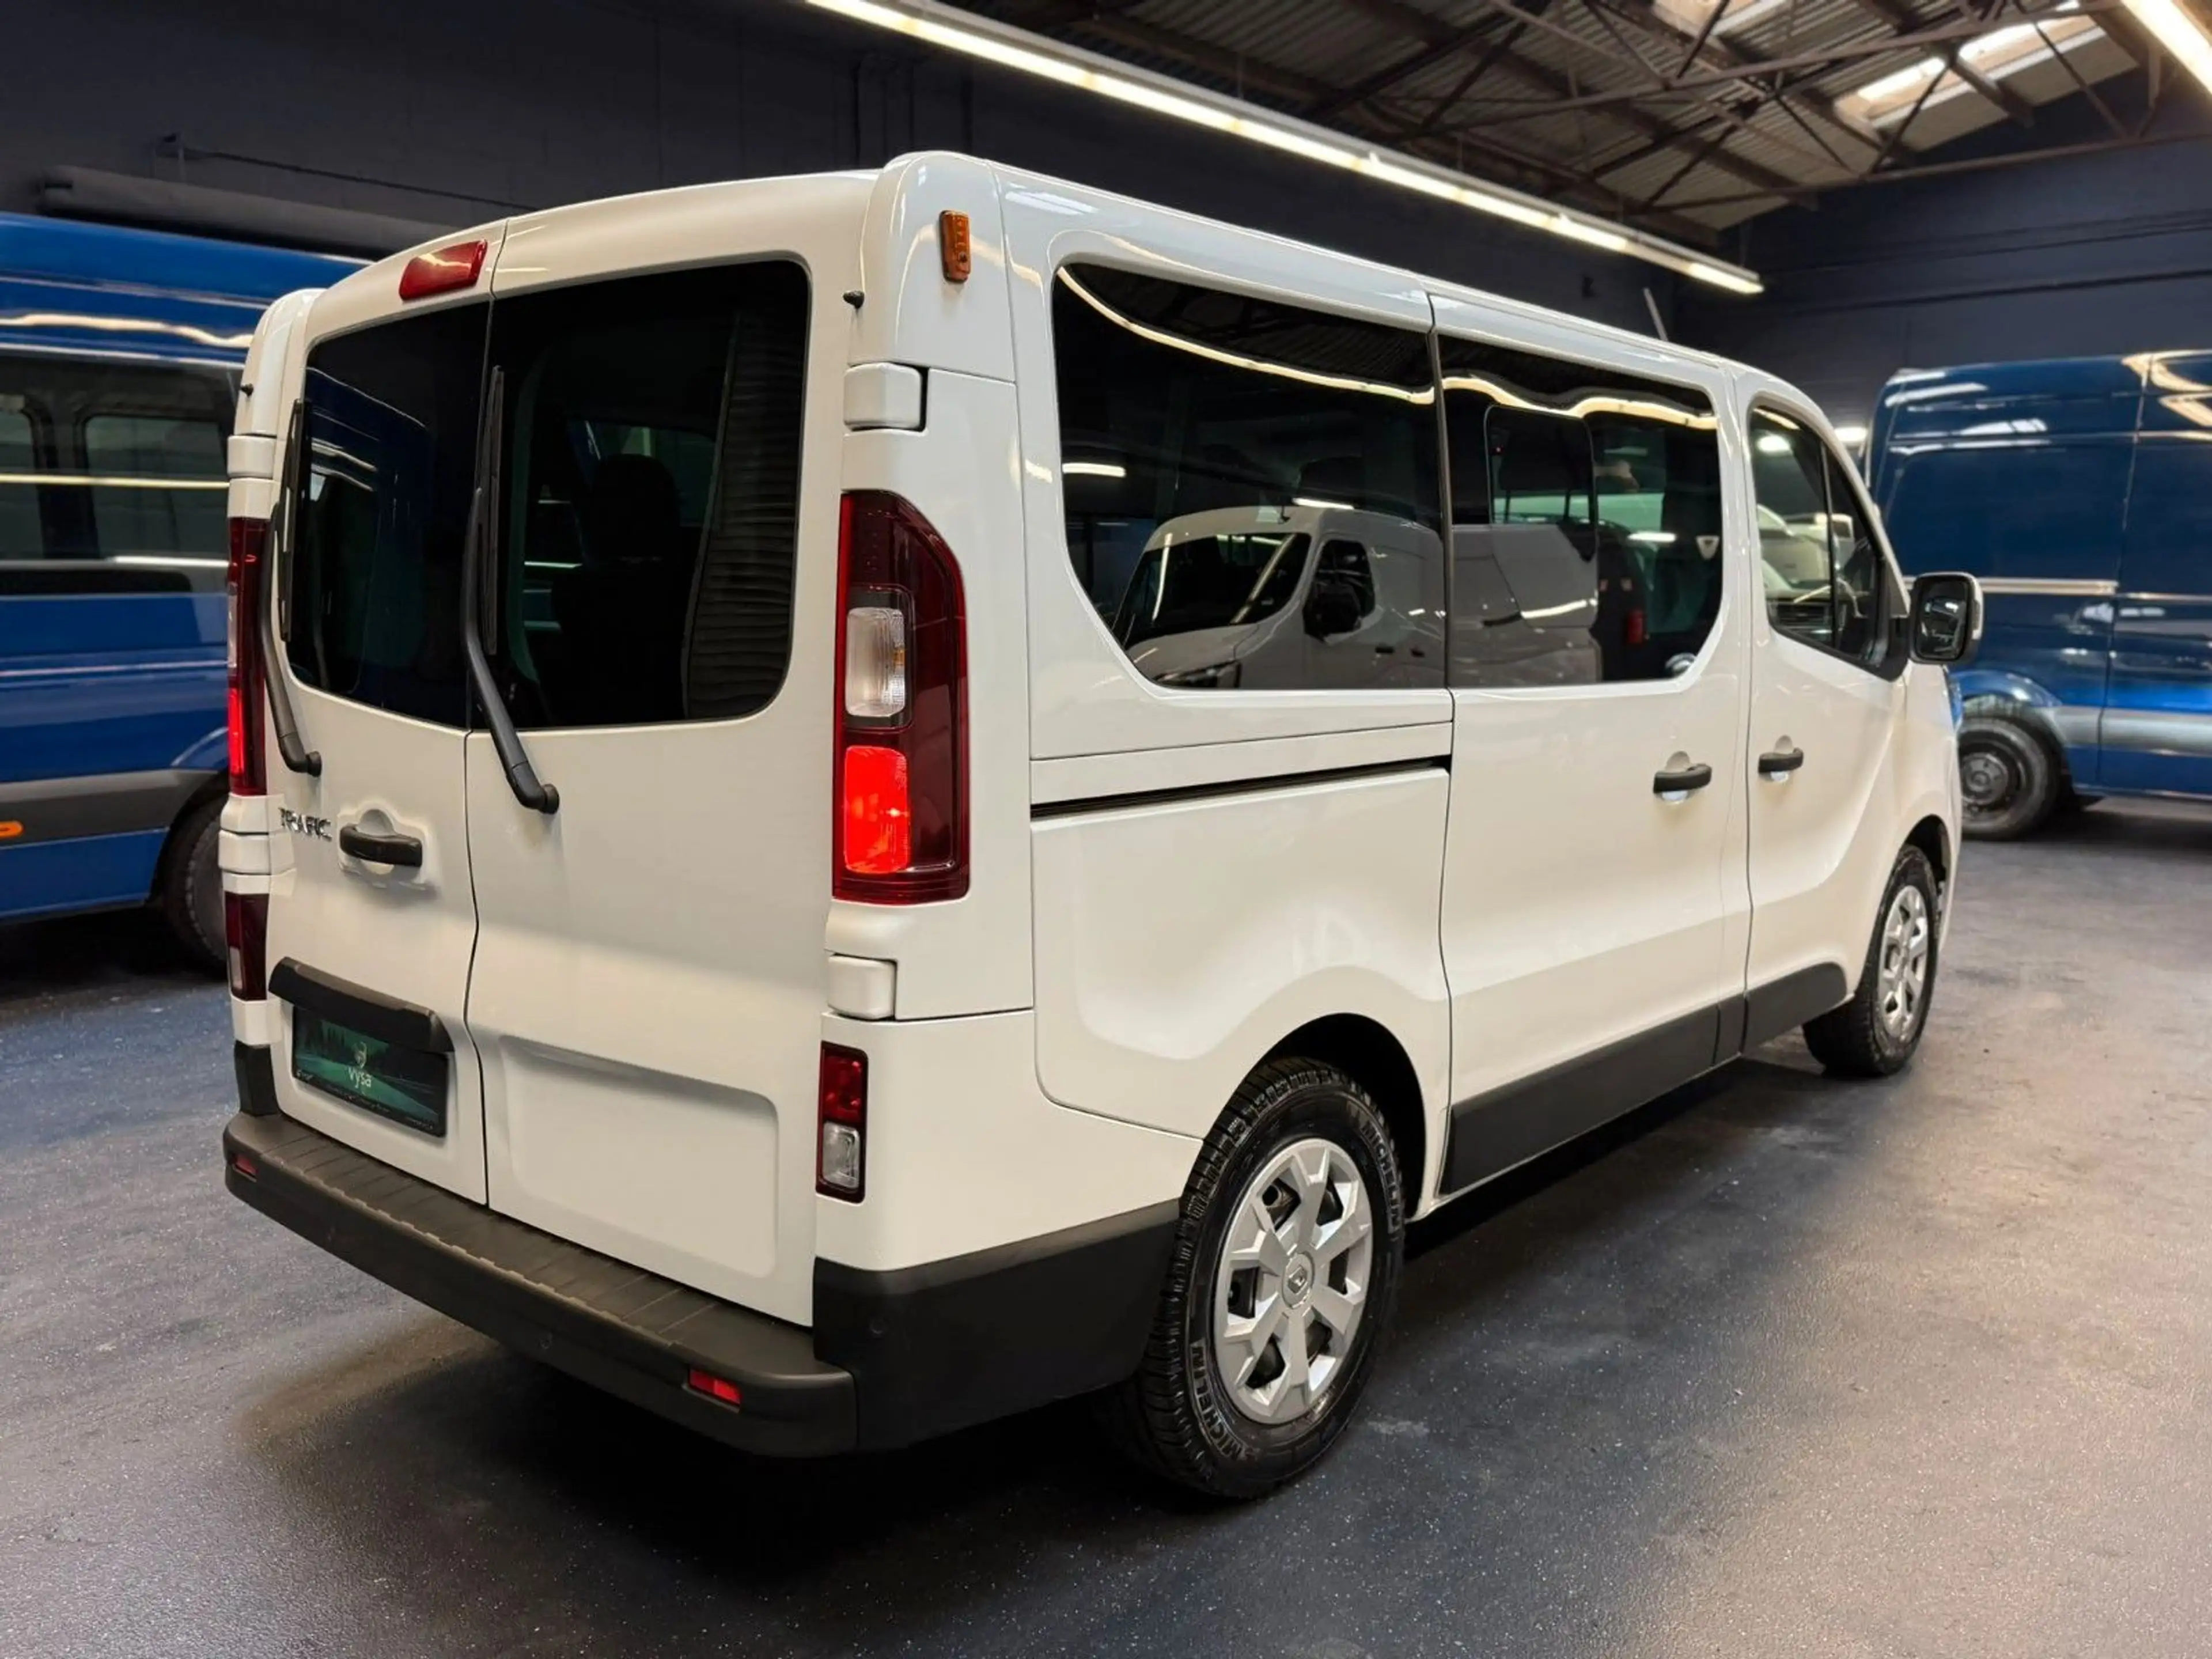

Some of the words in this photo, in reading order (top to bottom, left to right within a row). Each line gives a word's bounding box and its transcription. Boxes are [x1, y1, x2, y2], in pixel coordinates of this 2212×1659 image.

[278, 808, 332, 842] TRAFIC
[1360, 1120, 1401, 1232] MICHELIN
[1191, 1346, 1243, 1457] MICHELIN
